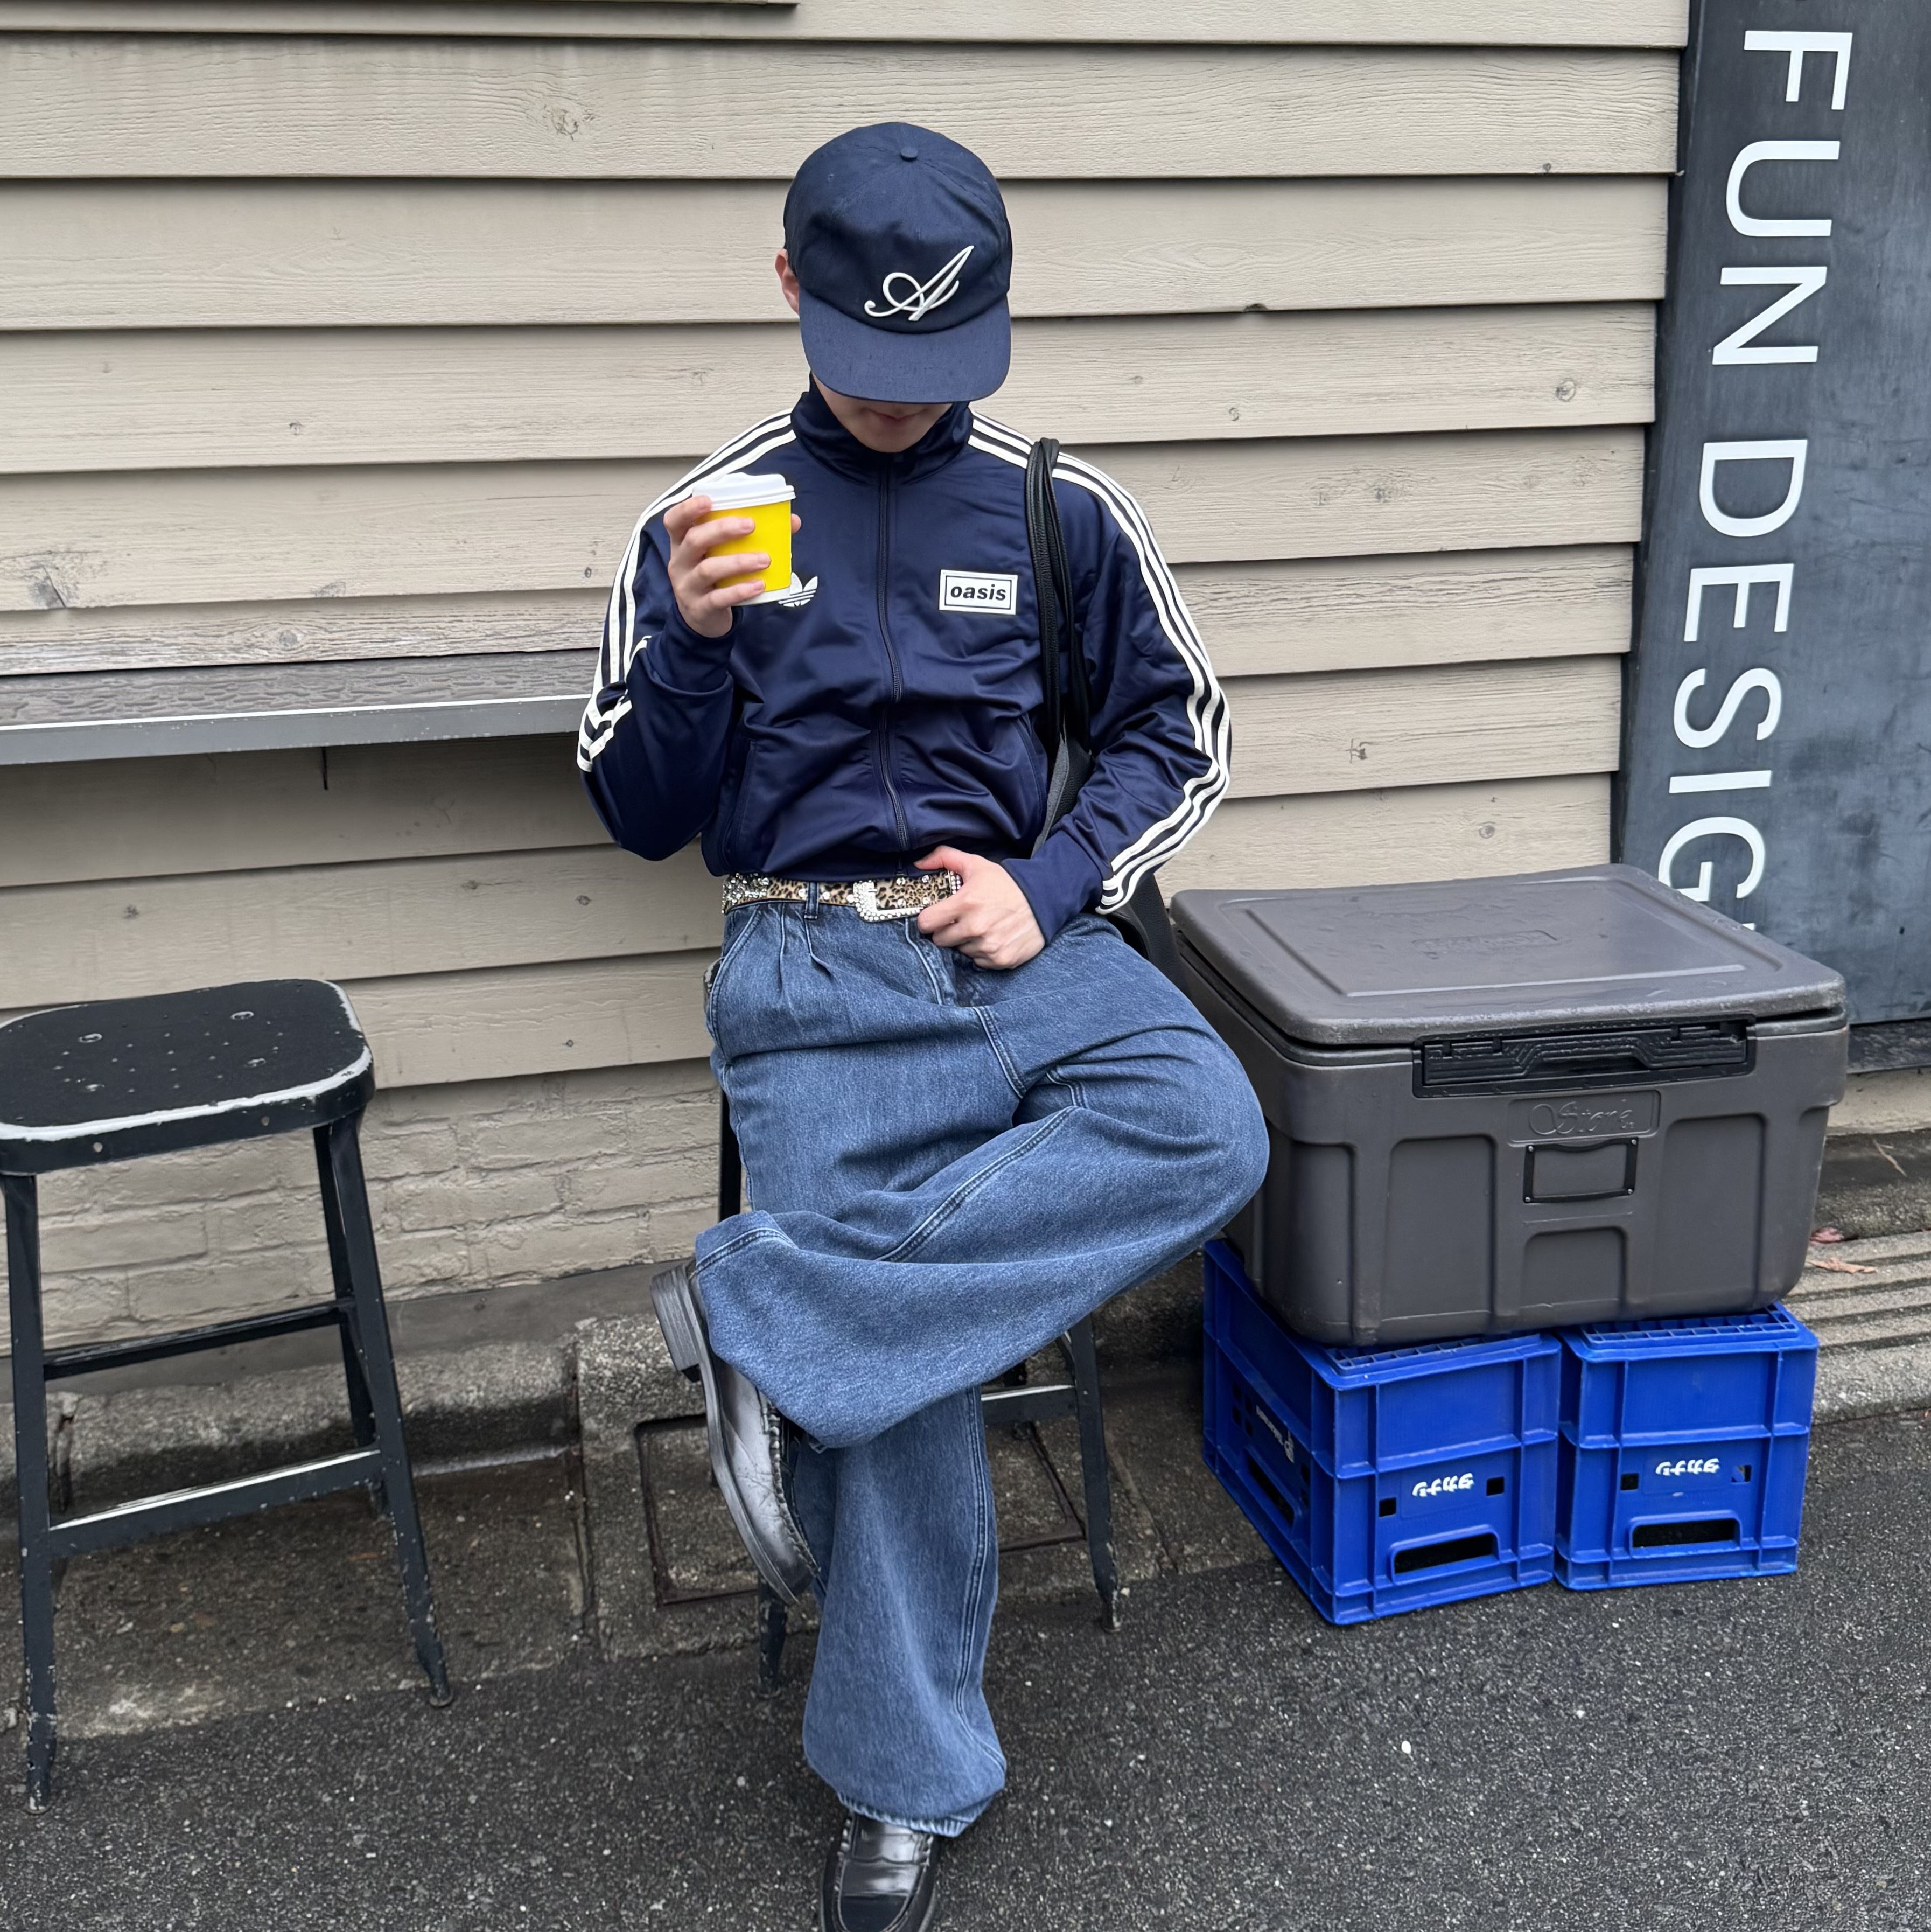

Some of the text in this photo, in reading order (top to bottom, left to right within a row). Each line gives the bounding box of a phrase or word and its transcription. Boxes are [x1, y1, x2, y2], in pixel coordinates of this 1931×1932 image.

[950, 584, 1006, 601] oasis
[1657, 30, 1853, 931] FUN DESIG
